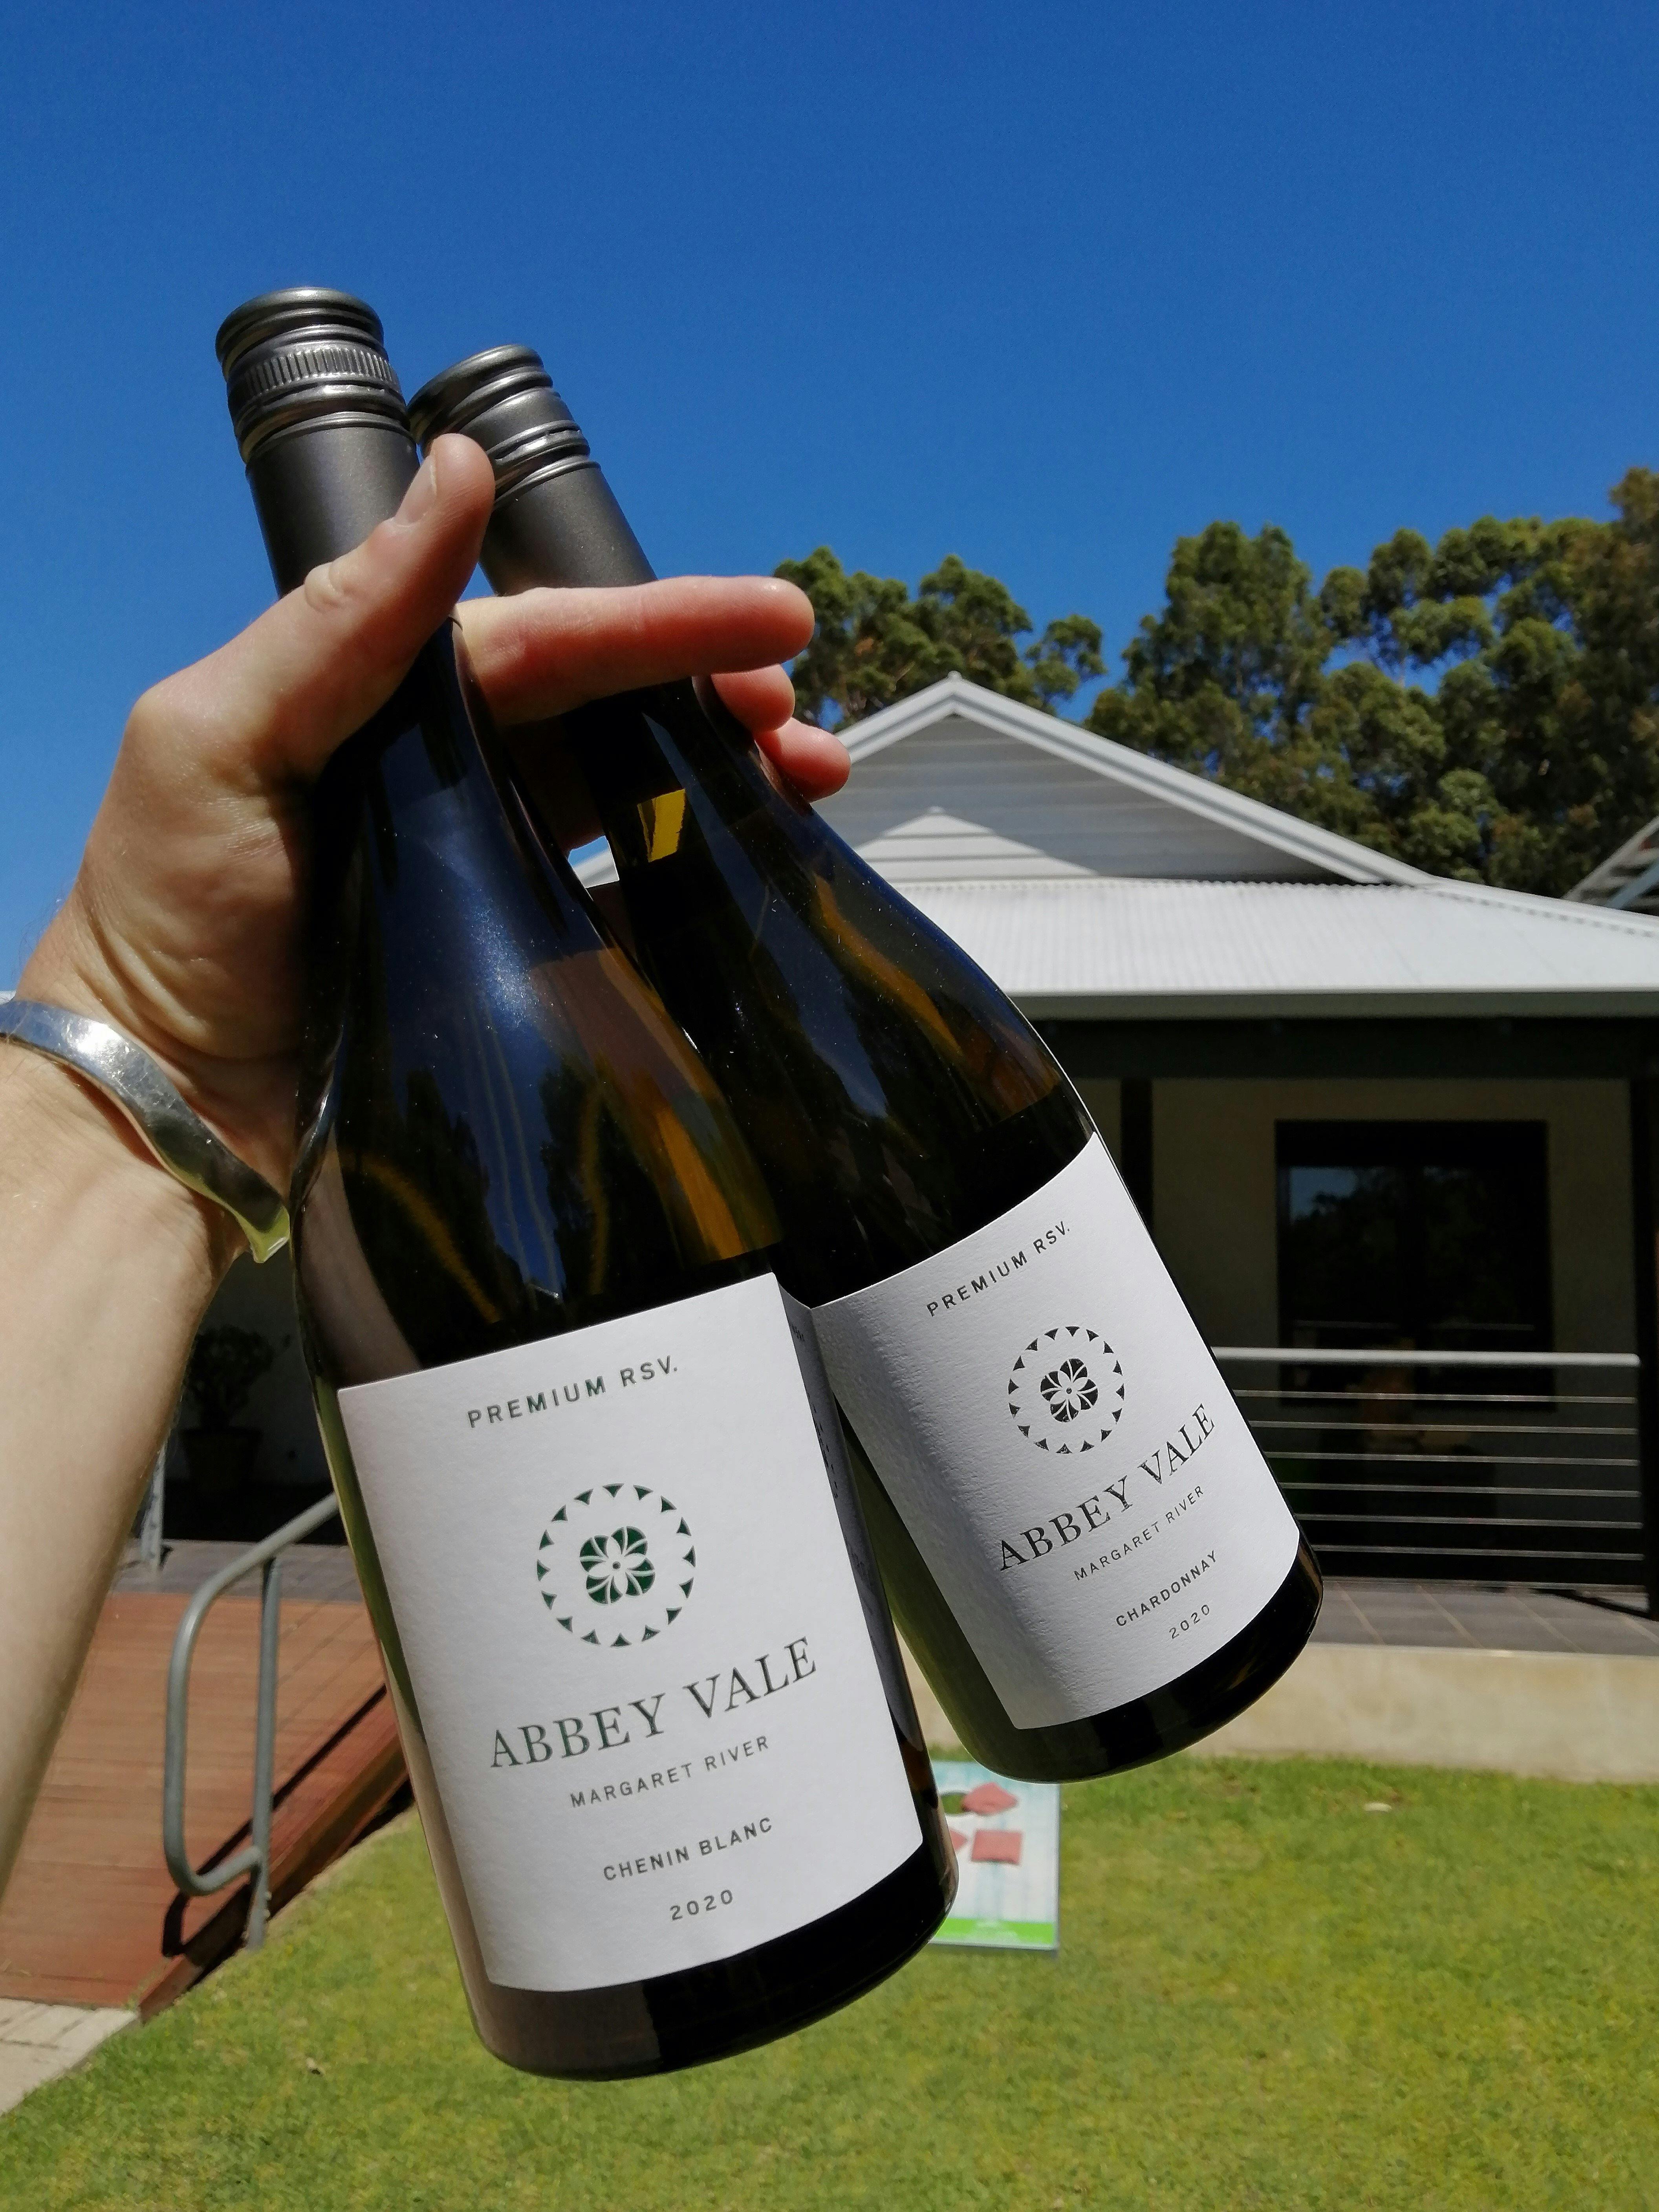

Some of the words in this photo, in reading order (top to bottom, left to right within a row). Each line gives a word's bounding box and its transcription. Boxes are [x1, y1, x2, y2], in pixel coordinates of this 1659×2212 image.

[925, 1250, 1028, 1318] PREMIUM
[1032, 1220, 1070, 1255] RSV.
[466, 1375, 607, 1429] PREMIUM
[619, 1354, 678, 1388] RSV.
[998, 1474, 1134, 1573] ABBEY
[1136, 1403, 1216, 1486] VALE
[1073, 1520, 1161, 1582] MARGARET
[1164, 1485, 1204, 1525] RIVER
[1115, 1549, 1217, 1627] CHARDONNAY
[1168, 1603, 1210, 1641] 2020
[489, 1692, 667, 1769] ABBEY
[681, 1635, 817, 1719] VALE
[569, 1762, 693, 1809] MARGARET
[703, 1735, 769, 1773] RIVER
[602, 1845, 690, 1882] CHENIN
[697, 1816, 773, 1857] BLANC
[668, 1888, 734, 1922] 2020
